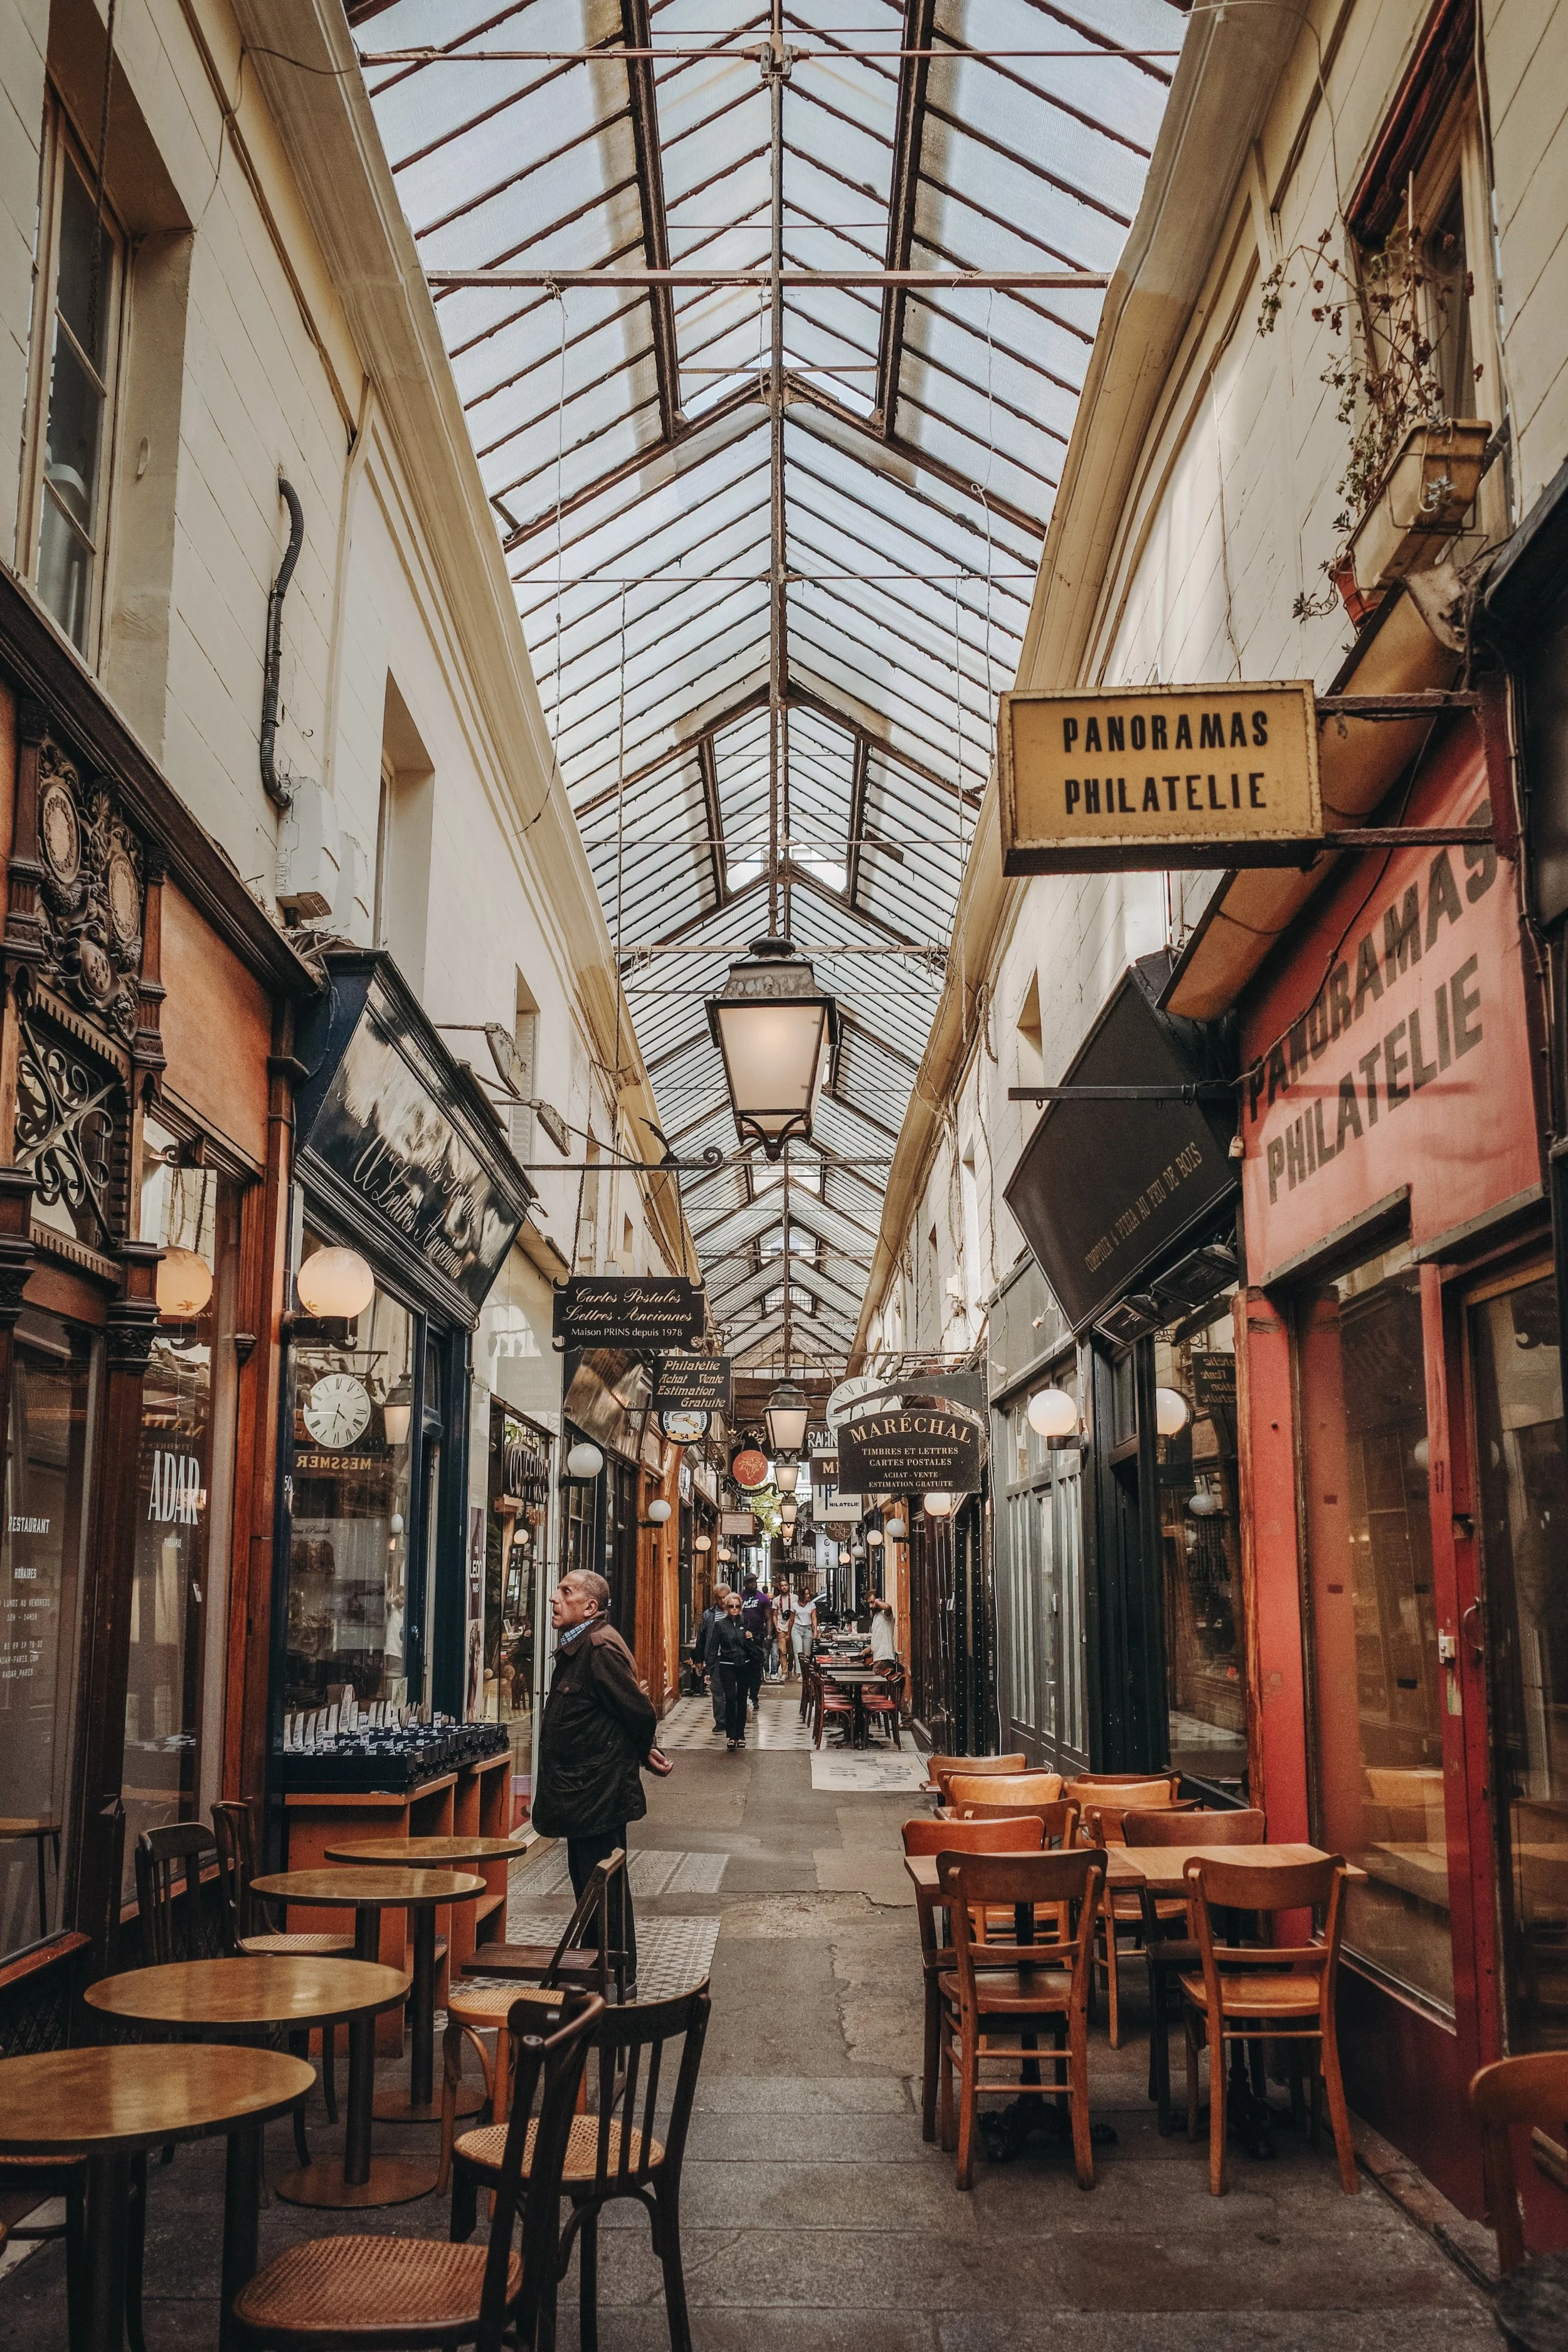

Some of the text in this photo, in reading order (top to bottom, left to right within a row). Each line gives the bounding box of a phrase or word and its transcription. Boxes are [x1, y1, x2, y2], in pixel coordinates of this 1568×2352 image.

[1062, 711, 1268, 753] PANORAMAS
[1064, 772, 1266, 815] PHILATELIE
[1248, 800, 1498, 1123] PANORAMAS
[1267, 953, 1483, 1205] PHILATELIE
[1115, 1209, 1140, 1239] PIZZA
[1136, 1195, 1150, 1219] AU
[1147, 1179, 1166, 1207] FEU
[1163, 1166, 1180, 1192] DE
[1175, 1142, 1203, 1178] BOIS
[372, 1158, 423, 1232] Lettres
[414, 1209, 467, 1279] Anciennes
[576, 1287, 682, 1304] Cartes Postales
[562, 1305, 693, 1322] Lettres Anciennes
[571, 1328, 601, 1336] Maison
[604, 1328, 630, 1336] PRINS
[632, 1328, 659, 1338] depuis
[663, 1360, 721, 1370] Philatélie
[659, 1374, 724, 1384] Achat Vente
[657, 1385, 716, 1396] Estimation
[681, 1397, 726, 1407] Gratuite
[849, 1412, 971, 1444] MARÉCHAL
[807, 1431, 838, 1448] RACIN
[147, 1450, 198, 1525] ADAR
[284, 1475, 292, 1491] 50
[8, 1516, 50, 1534] RESTAURANT
[14, 1567, 36, 1579] HORAIRES
[741, 1599, 760, 1610] NIKE
